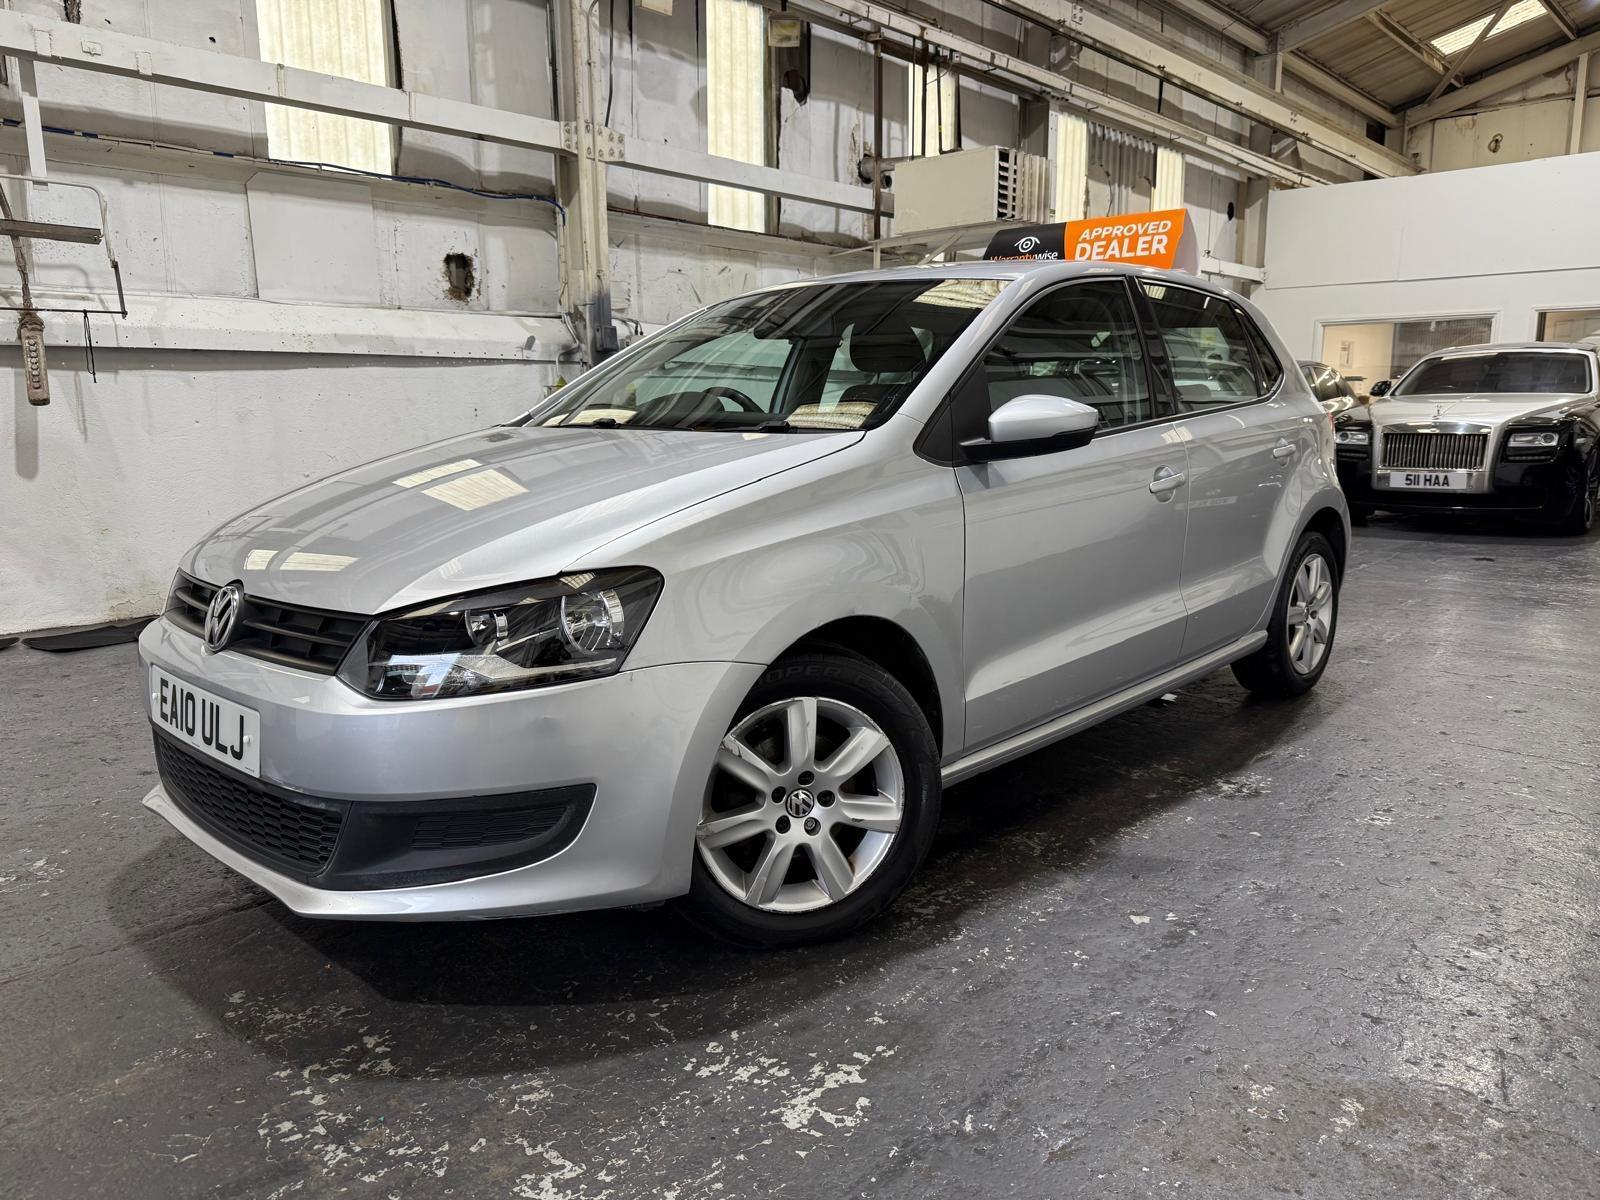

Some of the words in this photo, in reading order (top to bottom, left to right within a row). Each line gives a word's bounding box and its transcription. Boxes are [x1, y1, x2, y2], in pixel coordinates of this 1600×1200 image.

[1078, 220, 1172, 241] APPROVED
[990, 249, 1059, 261] ntywise
[1075, 234, 1167, 261] DEALER
[1424, 474, 1449, 487] HAA
[160, 677, 196, 737] EA10
[201, 698, 244, 761] ULJ
